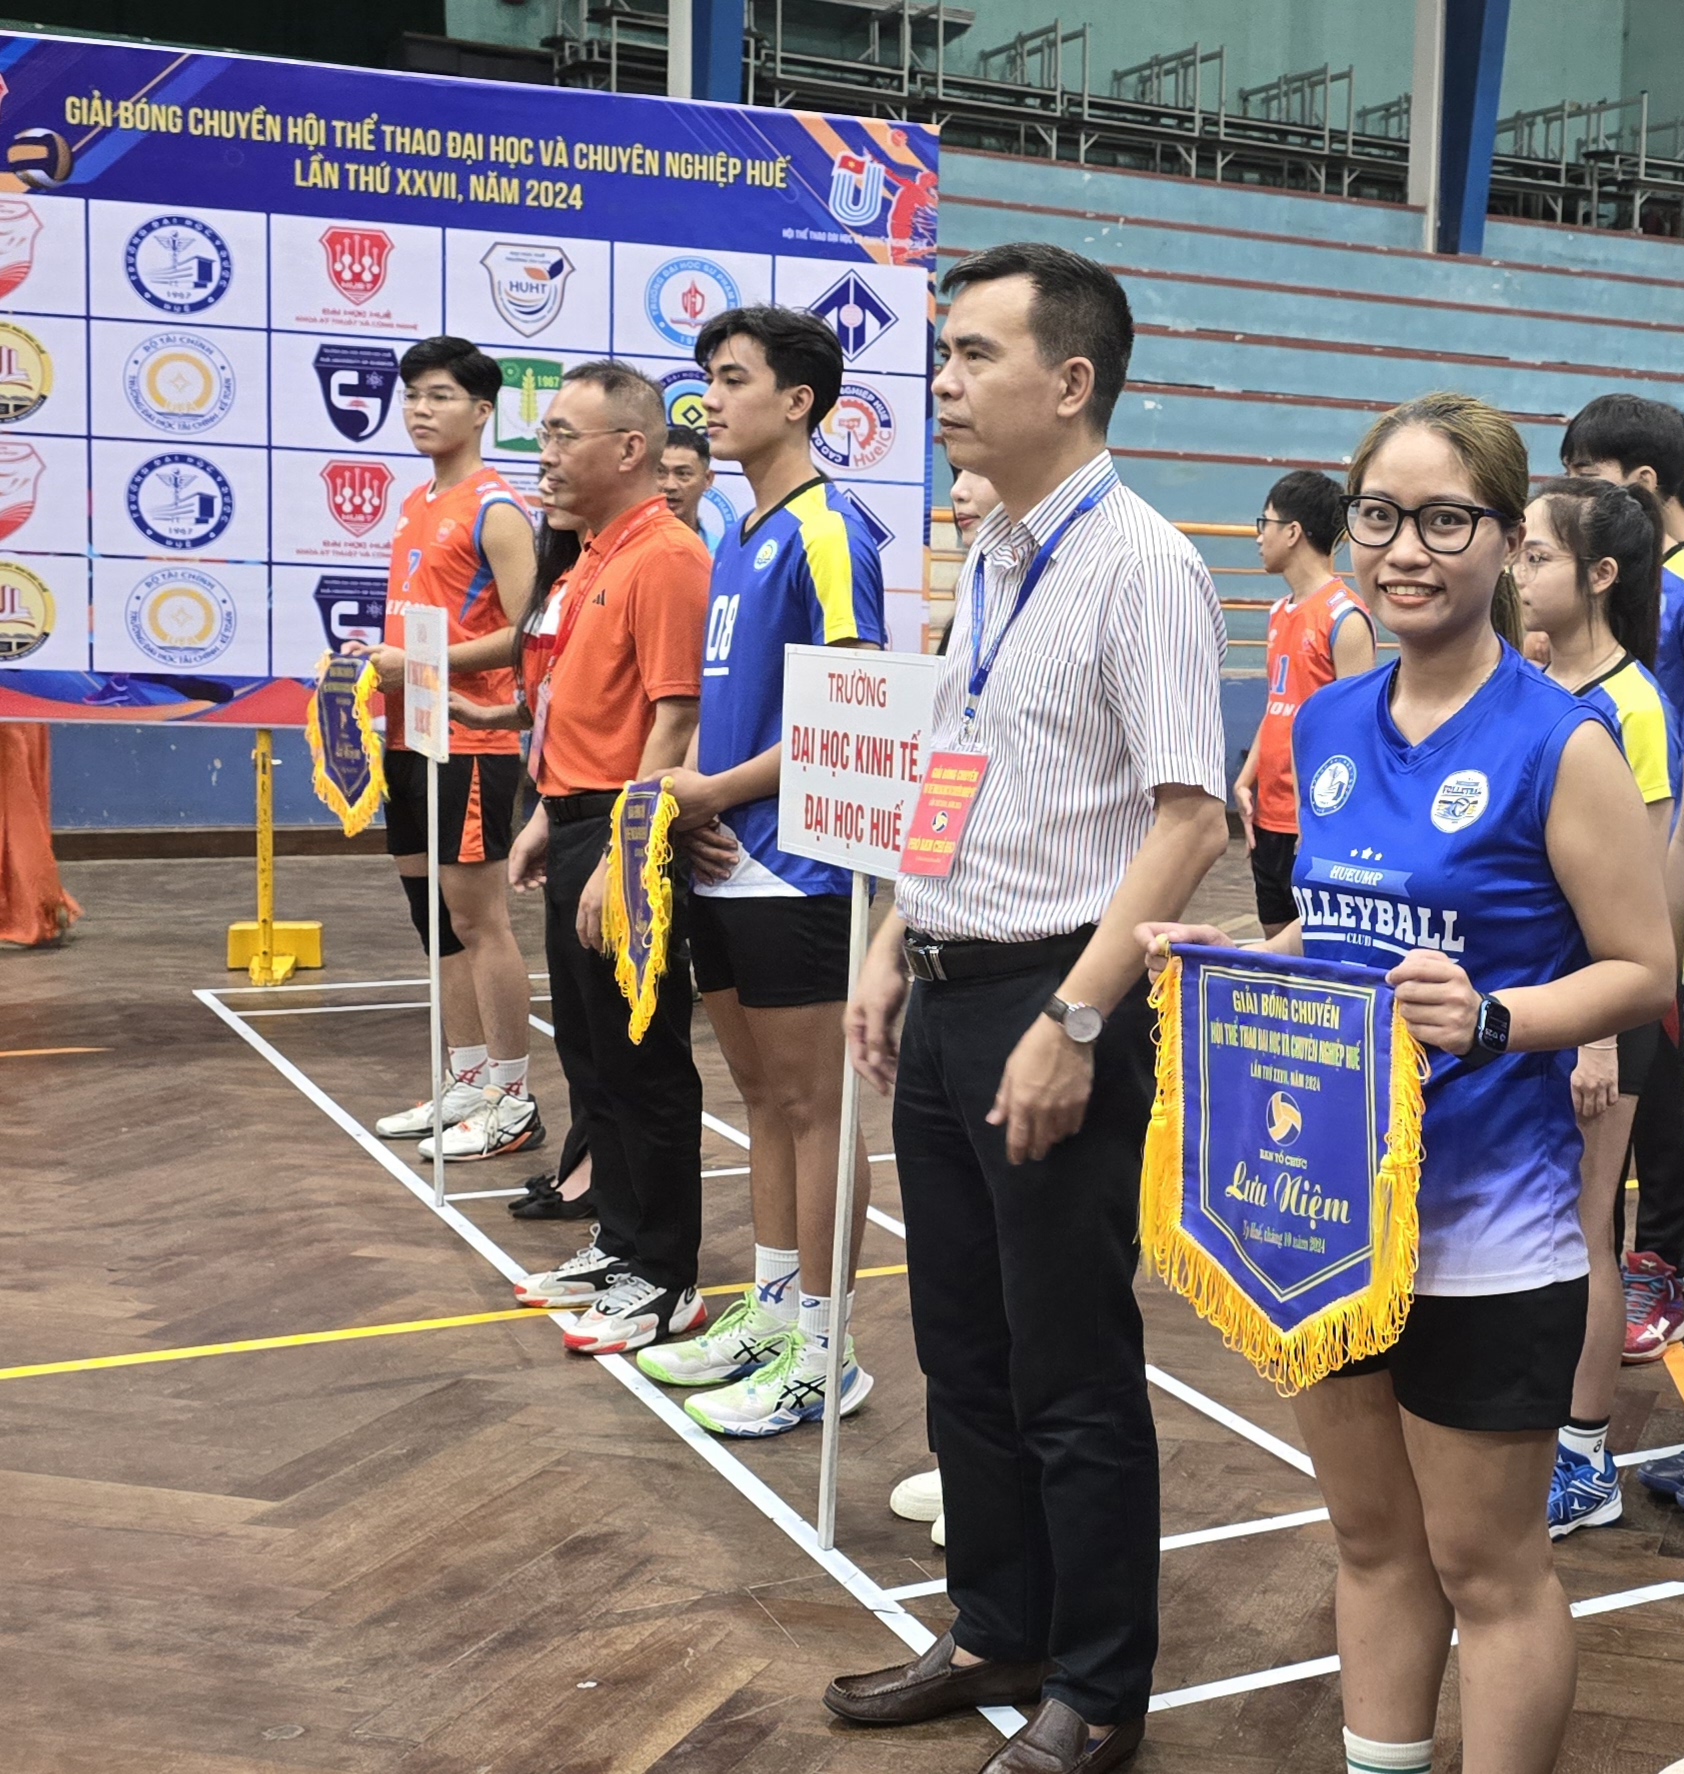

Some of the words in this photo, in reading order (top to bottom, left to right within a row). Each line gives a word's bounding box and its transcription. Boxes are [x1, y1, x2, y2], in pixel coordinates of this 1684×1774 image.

[65, 89, 112, 127] GIẢI
[118, 98, 182, 133] BÓNG
[188, 105, 282, 143] CHUYỀN
[287, 112, 326, 151] HỘI
[332, 113, 377, 150] THỂ
[381, 124, 439, 157] THAO
[446, 130, 484, 165] ĐẠI
[489, 135, 533, 169] HỌC
[539, 136, 568, 169] VÀ
[573, 143, 660, 177] CHUYÊN
[664, 151, 742, 188] NGHIỆP
[746, 154, 792, 189] HUẾ
[294, 151, 340, 190] LẦN
[345, 161, 390, 194] THỨ
[396, 168, 463, 204] XXVII,
[469, 171, 520, 205] NĂM
[525, 179, 583, 210] 2024
[509, 280, 547, 294] HUHT
[828, 668, 887, 708] TRƯỜNG
[791, 725, 814, 771] ĐẠI
[820, 730, 850, 777] HỌC
[855, 733, 895, 779] KINH
[804, 793, 829, 842] ĐẠI
[833, 798, 865, 849] HỌC
[870, 799, 904, 852] HUẾ
[1329, 864, 1384, 887] HUEUMP
[1346, 932, 1372, 947] CLUB
[1232, 985, 1259, 1015] GIẢI
[1261, 987, 1289, 1021] BÓNG
[1291, 996, 1341, 1030] CHUYỀN
[1305, 1075, 1321, 1092] 2024
[1225, 1161, 1268, 1207] Lưu
[1273, 1172, 1351, 1230] Niệm
